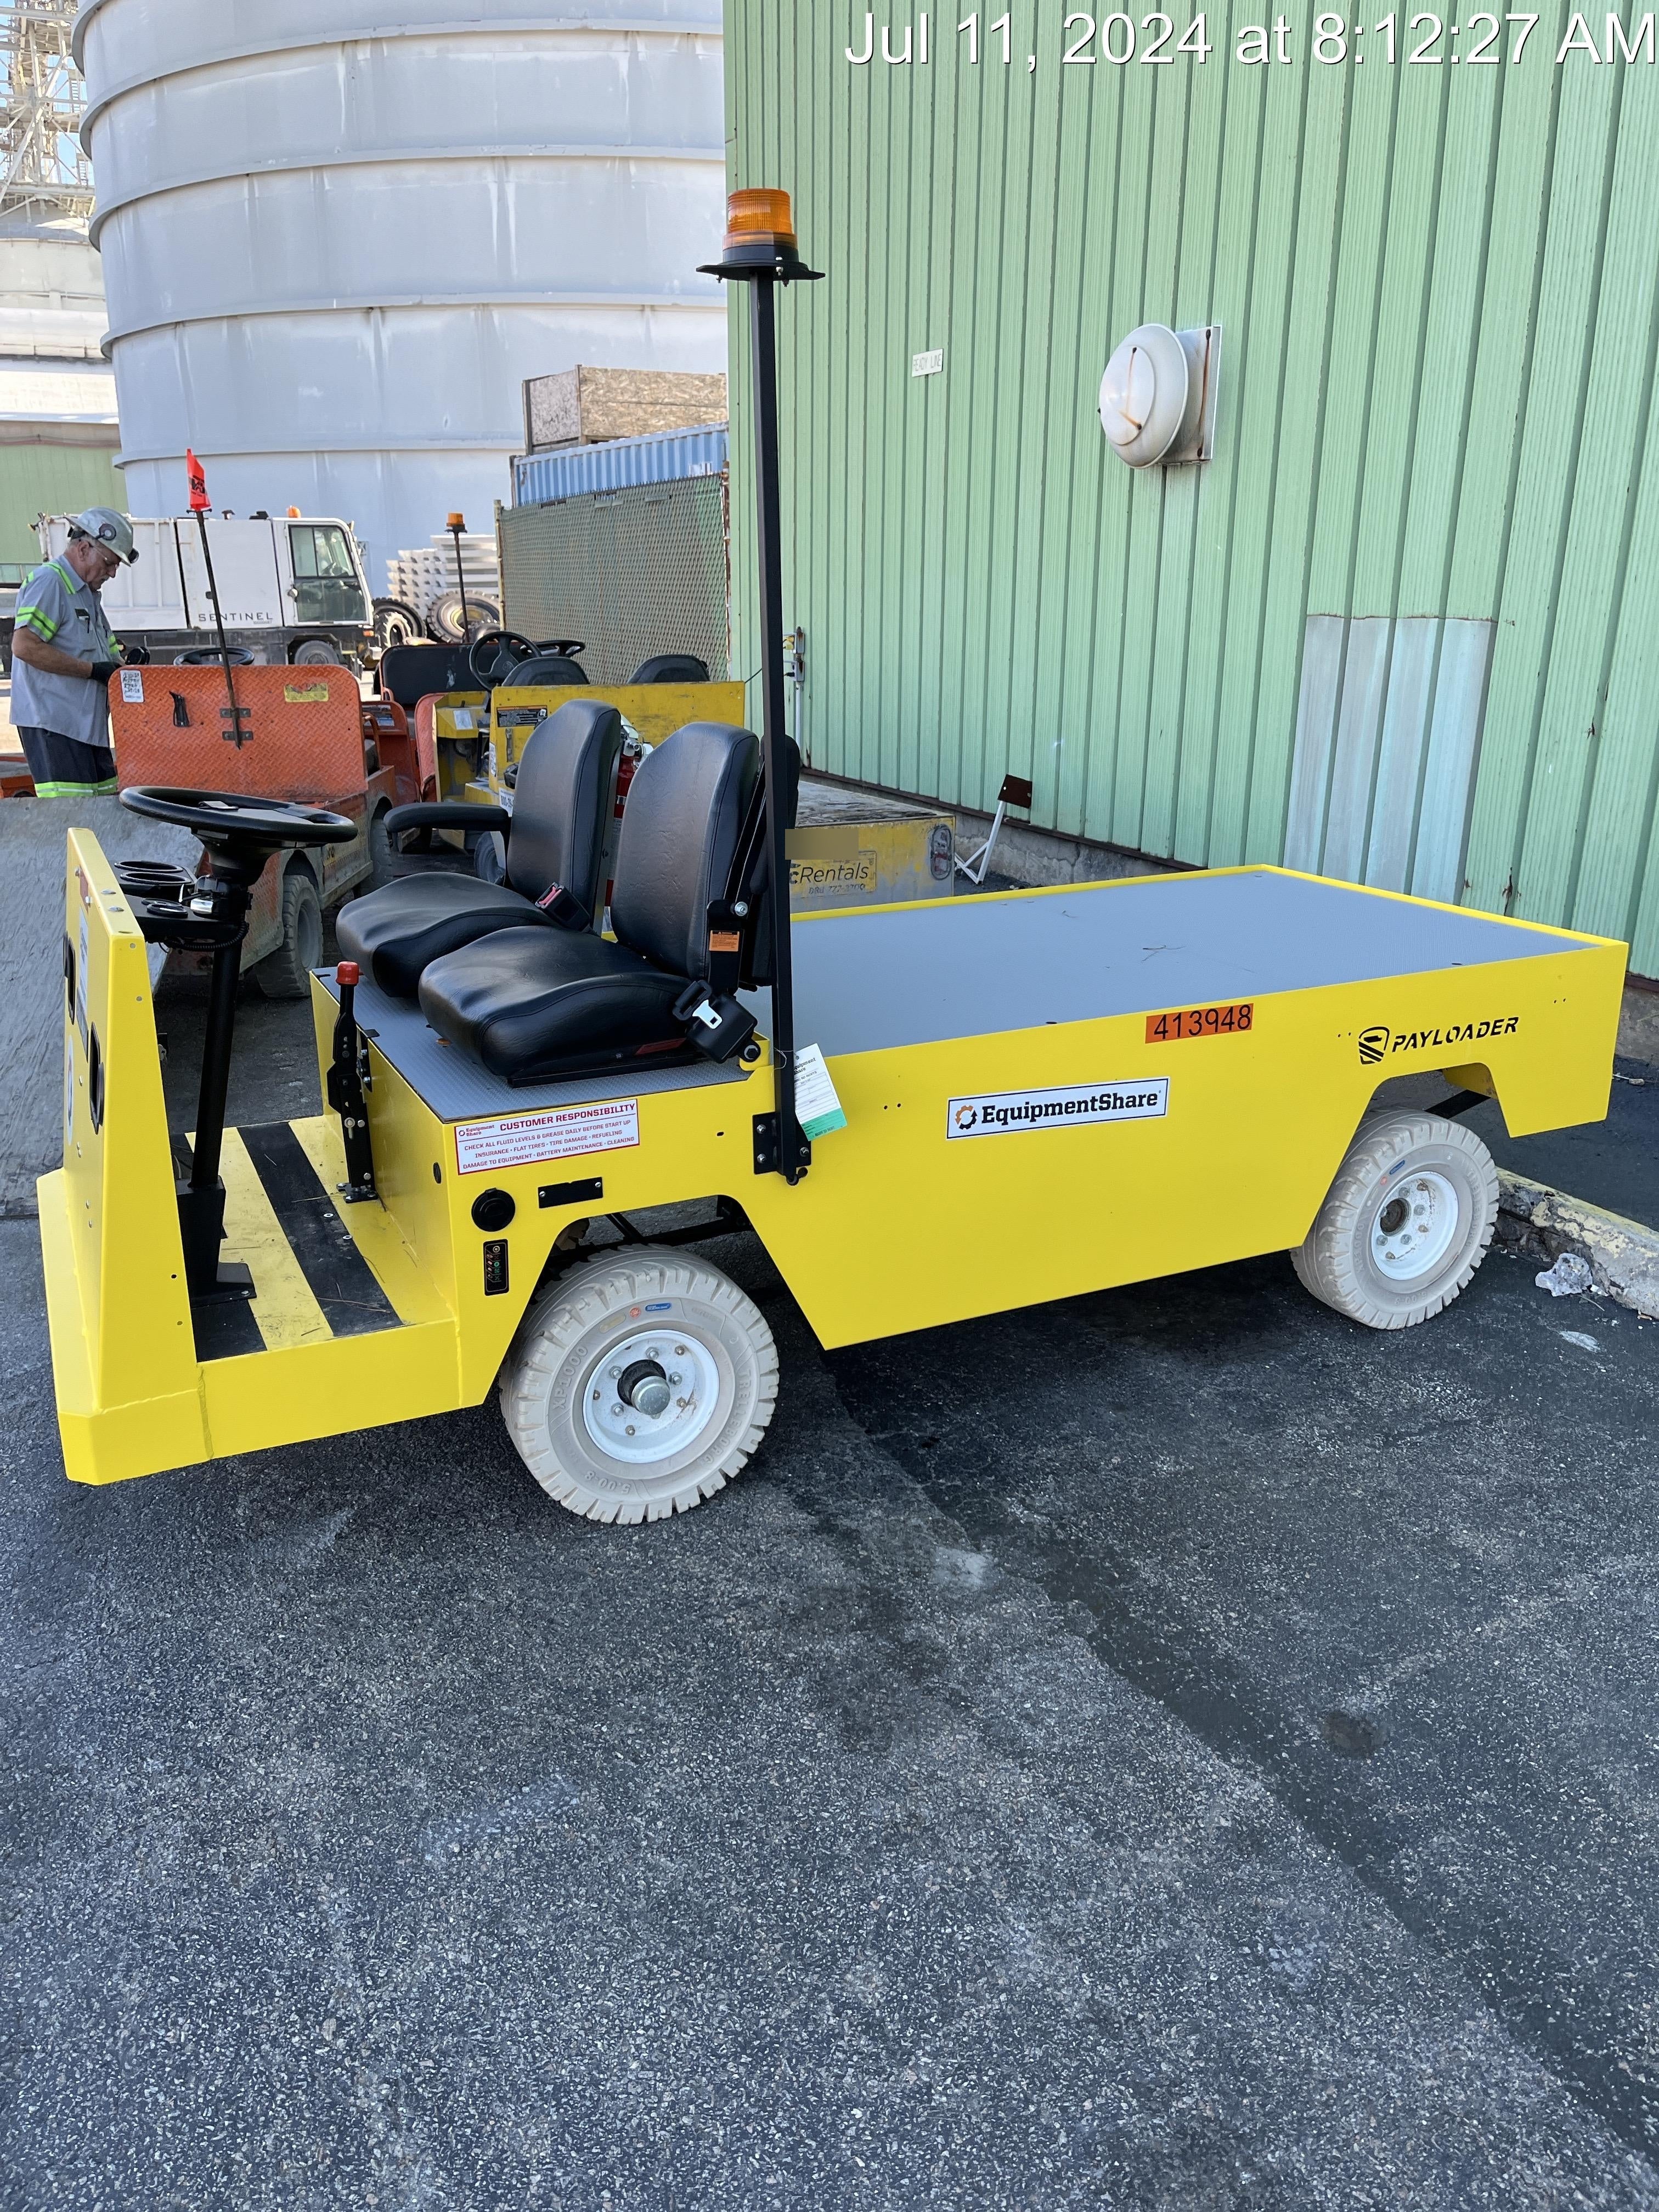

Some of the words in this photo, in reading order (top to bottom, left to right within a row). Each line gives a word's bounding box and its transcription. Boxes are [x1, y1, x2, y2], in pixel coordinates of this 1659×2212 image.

[198, 612, 273, 622] SENTINEL
[1153, 1004, 1251, 1040] 413948
[1391, 1017, 1519, 1053] PAYLOADER
[500, 1116, 554, 1131] CUSTOMER
[556, 1103, 635, 1122] RESPONSIBILITY
[981, 1091, 1159, 1126] EquipmentShare
[464, 1143, 484, 1151] CHECK
[542, 1130, 564, 1138] GREASE
[466, 1124, 495, 1132] Equipment
[463, 1160, 488, 1169] DAMAGE
[498, 1153, 532, 1164] EQUIPMENT
[537, 1149, 561, 1157] BATTERY
[562, 1142, 603, 1153] MAINTENANCE
[607, 1136, 635, 1145] CLEANING
[475, 1149, 509, 1158] INSURANCE
[564, 1135, 588, 1144] DAMAGE
[592, 1130, 623, 1139] REFUELING
[552, 1346, 588, 1409] XP1000
[703, 1368, 752, 1464] TRELLEBORG
[584, 1470, 631, 1494] 5.00-8
